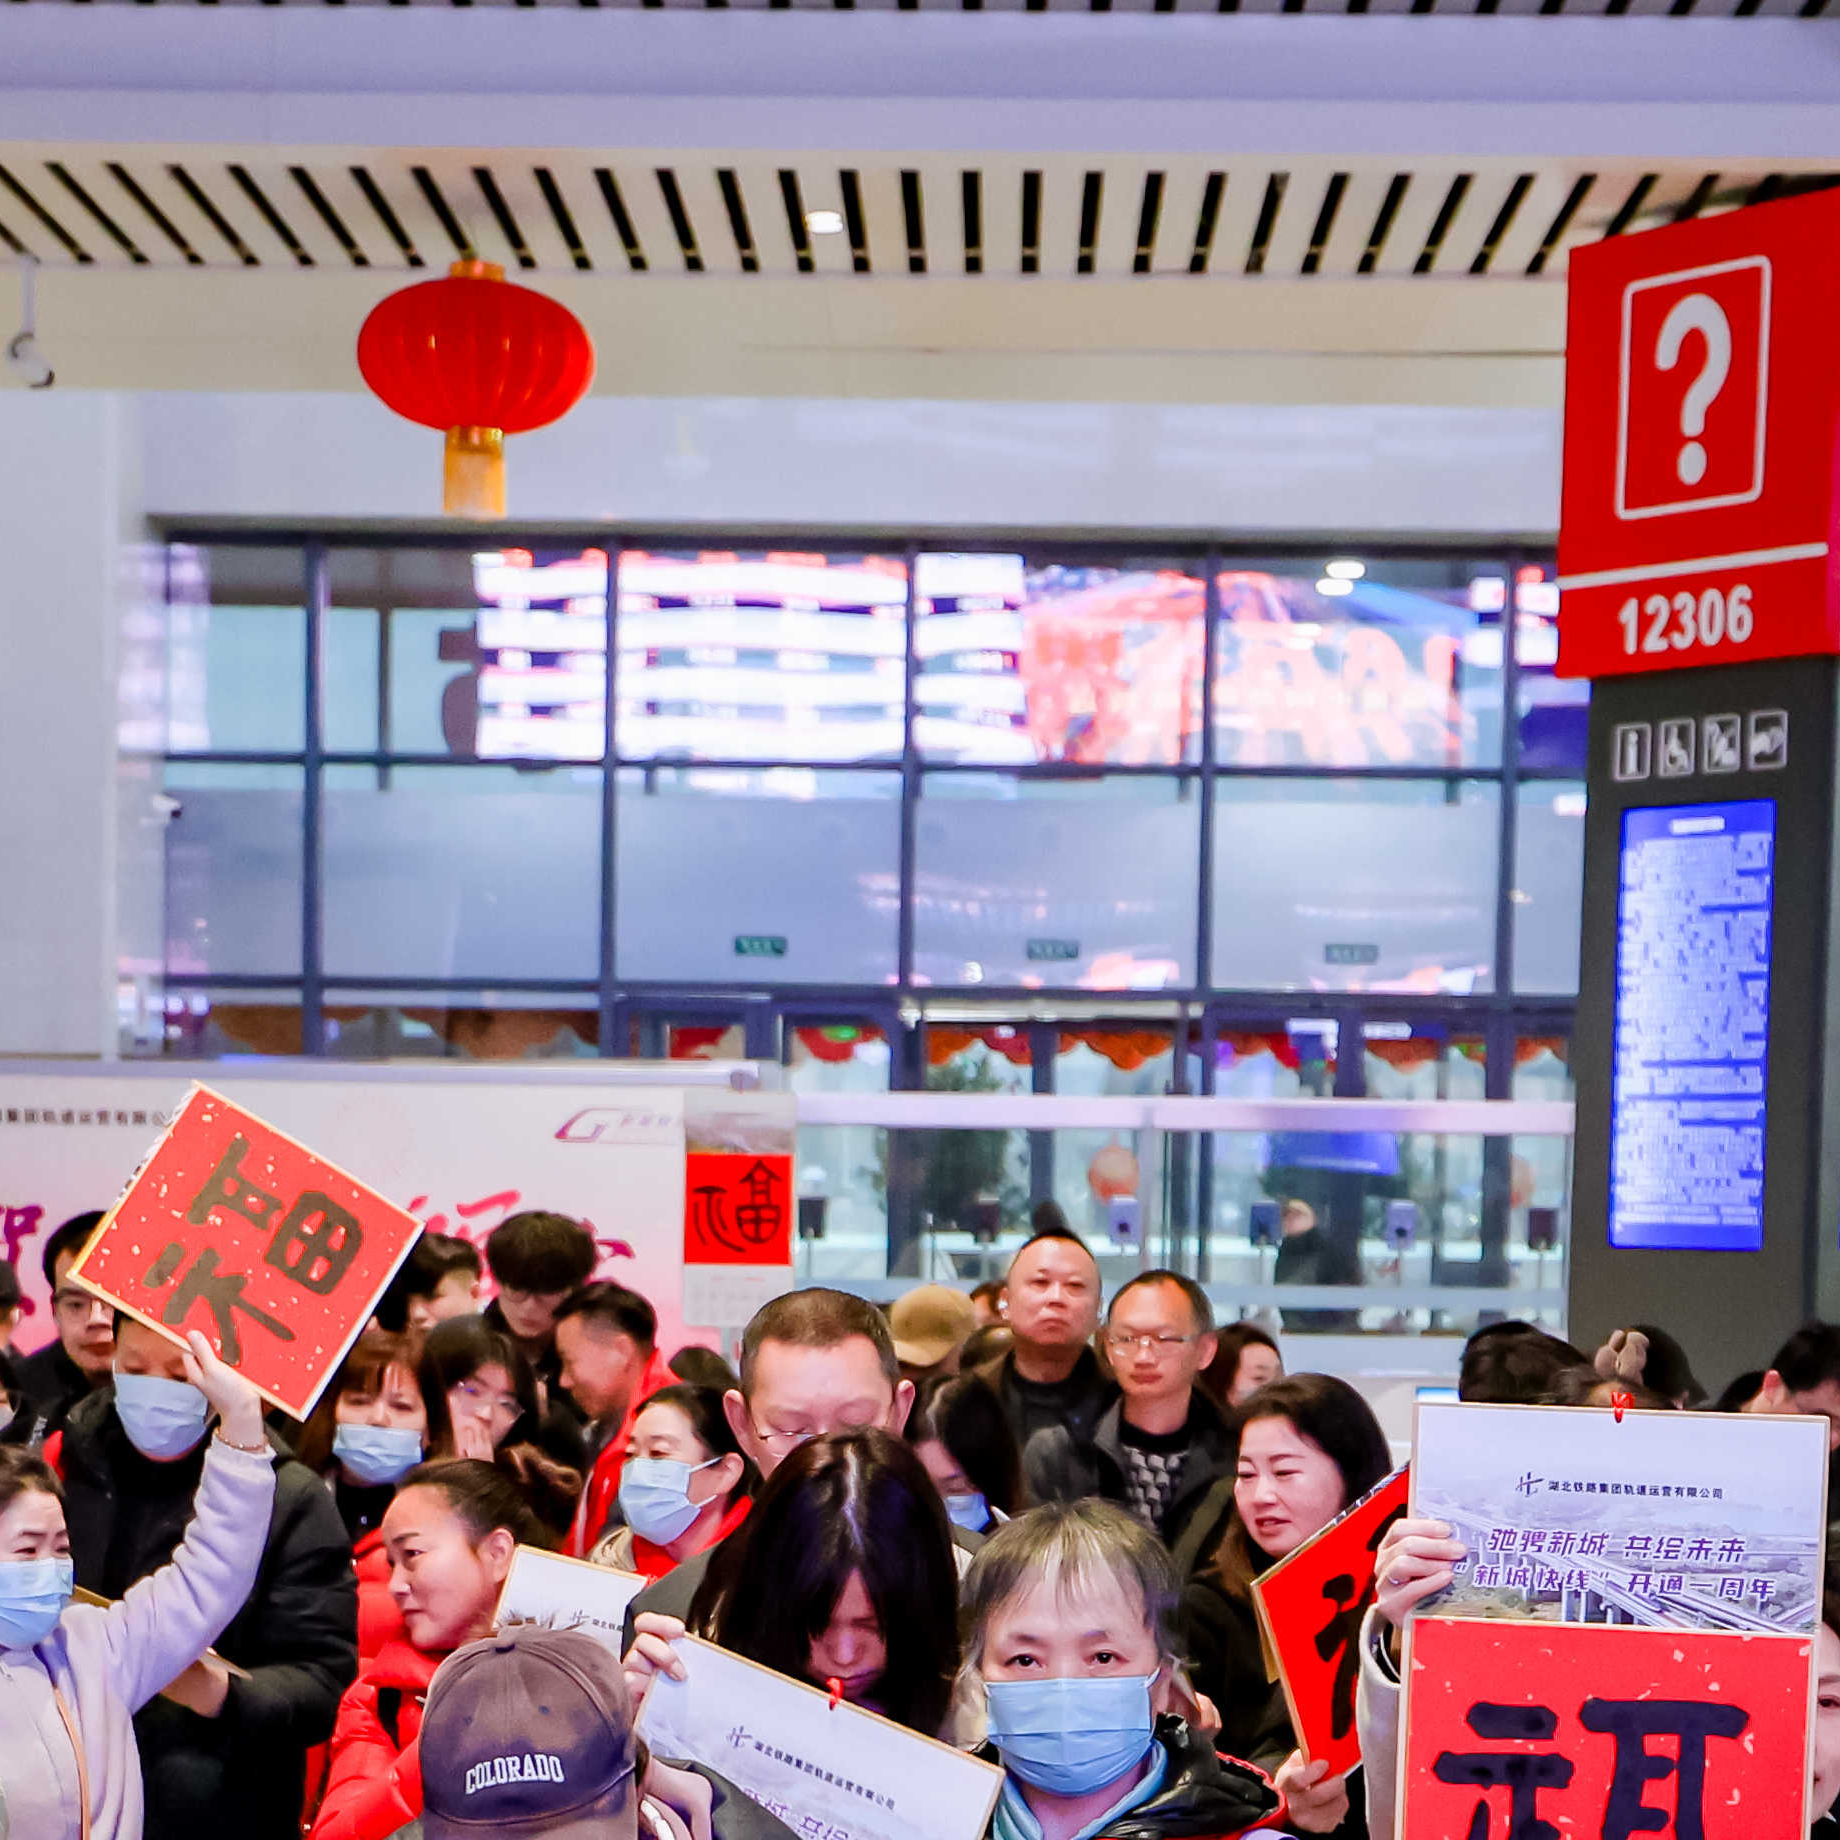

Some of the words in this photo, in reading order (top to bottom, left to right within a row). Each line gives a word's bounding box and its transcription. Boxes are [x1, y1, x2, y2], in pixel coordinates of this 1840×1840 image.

[1618, 585, 1753, 655] 12306
[143, 1135, 363, 1365] 福
[1547, 1480, 1723, 1500] 湖北铁路集团轨道运营有限公司
[1487, 1528, 1610, 1556] 驰骋新城
[1624, 1535, 1746, 1563] 共绘未来
[1627, 1572, 1777, 1601] 开通一周年
[465, 1753, 566, 1795] COLORADO
